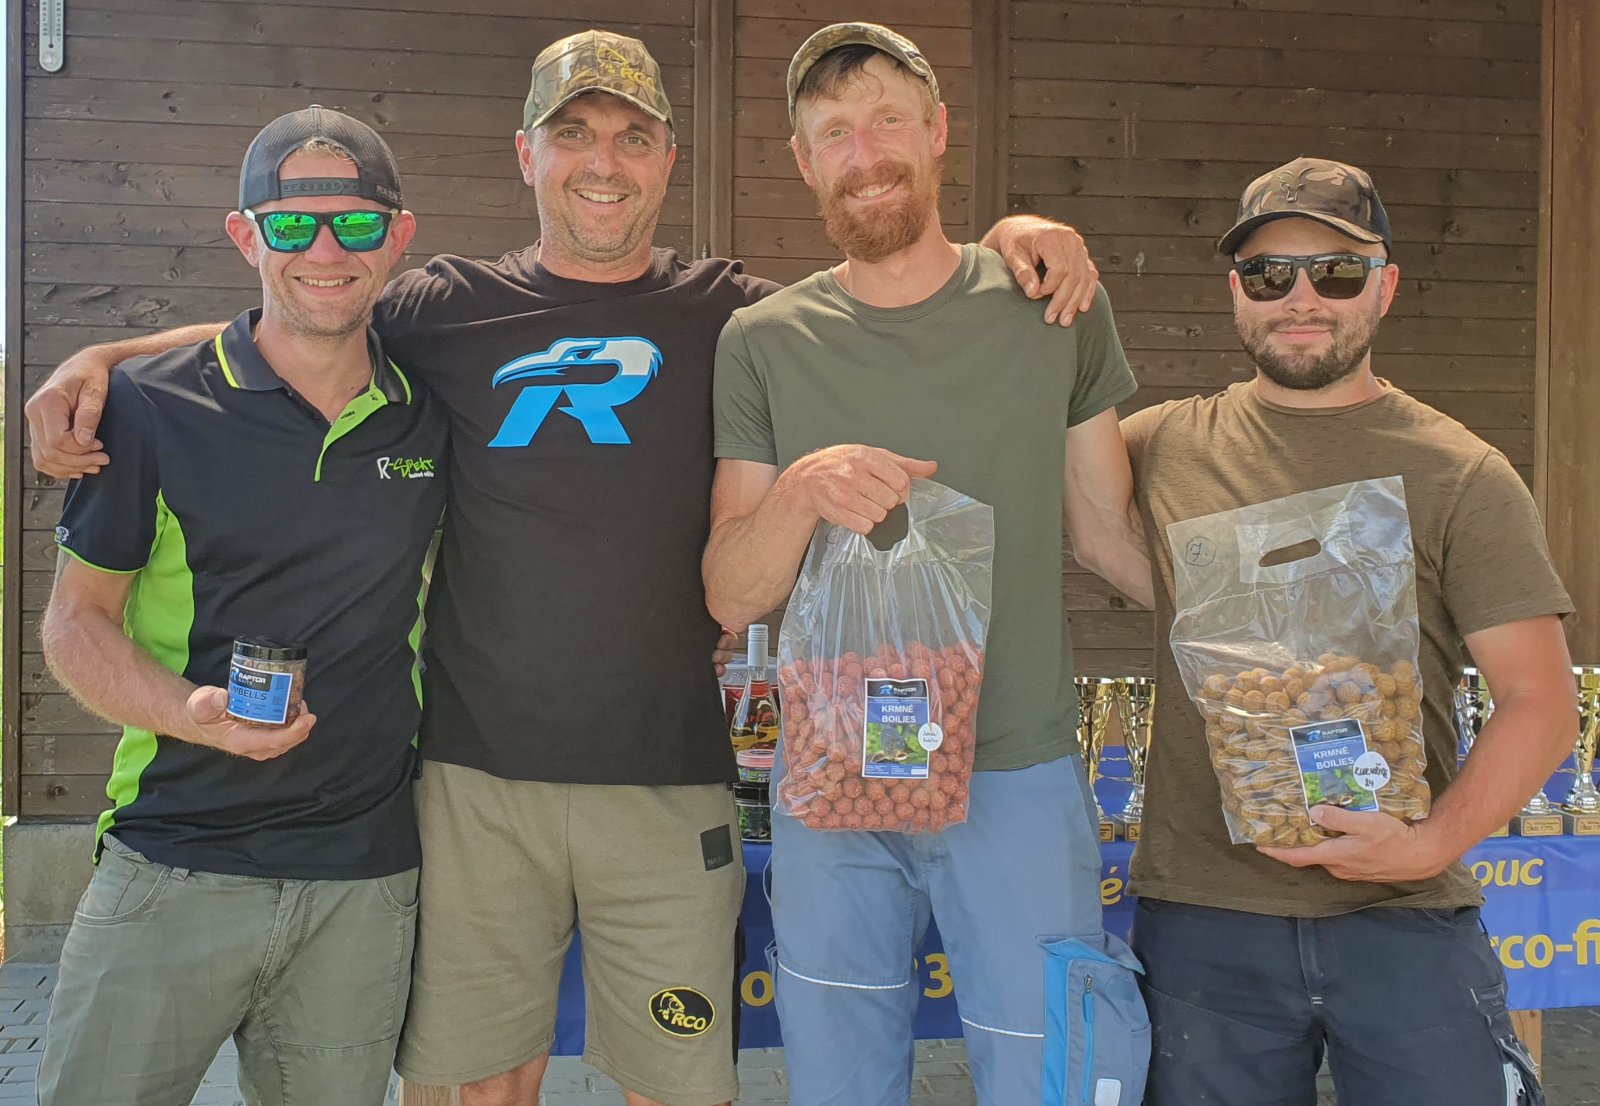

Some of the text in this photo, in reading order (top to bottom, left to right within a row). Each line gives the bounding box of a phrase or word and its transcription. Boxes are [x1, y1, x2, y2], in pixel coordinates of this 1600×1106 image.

[239, 672, 266, 684] RAPTOR
[881, 704, 914, 713] KRMNÉ
[881, 715, 917, 723] BOILIES
[1313, 746, 1349, 759] KRMNÉ
[1316, 757, 1354, 769] BOILIES
[671, 1012, 707, 1030] RCO
